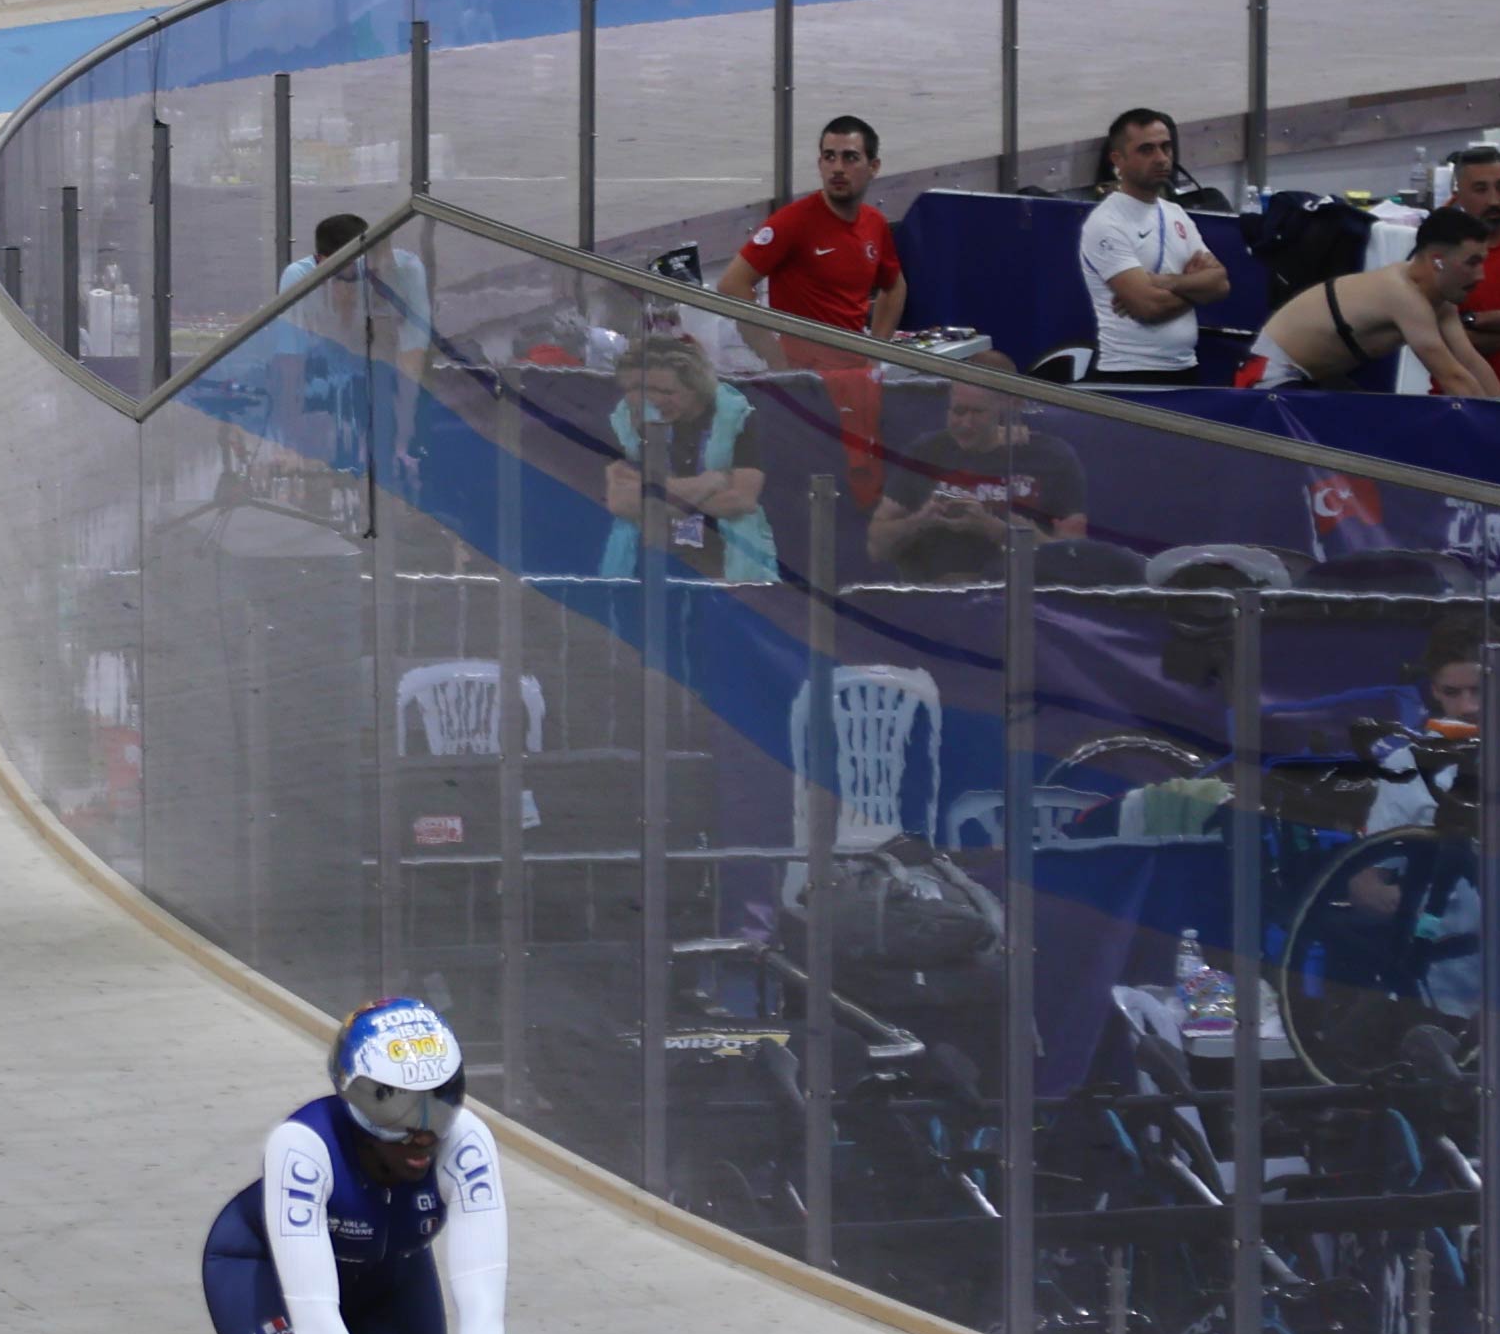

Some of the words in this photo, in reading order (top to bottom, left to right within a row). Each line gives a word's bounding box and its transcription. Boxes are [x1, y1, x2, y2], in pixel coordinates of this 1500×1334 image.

[370, 1007, 440, 1033] TODAY
[387, 1034, 448, 1063] GOOD
[401, 1058, 443, 1085] DAY
[455, 1144, 493, 1204] CIC
[287, 1160, 321, 1228] CIC
